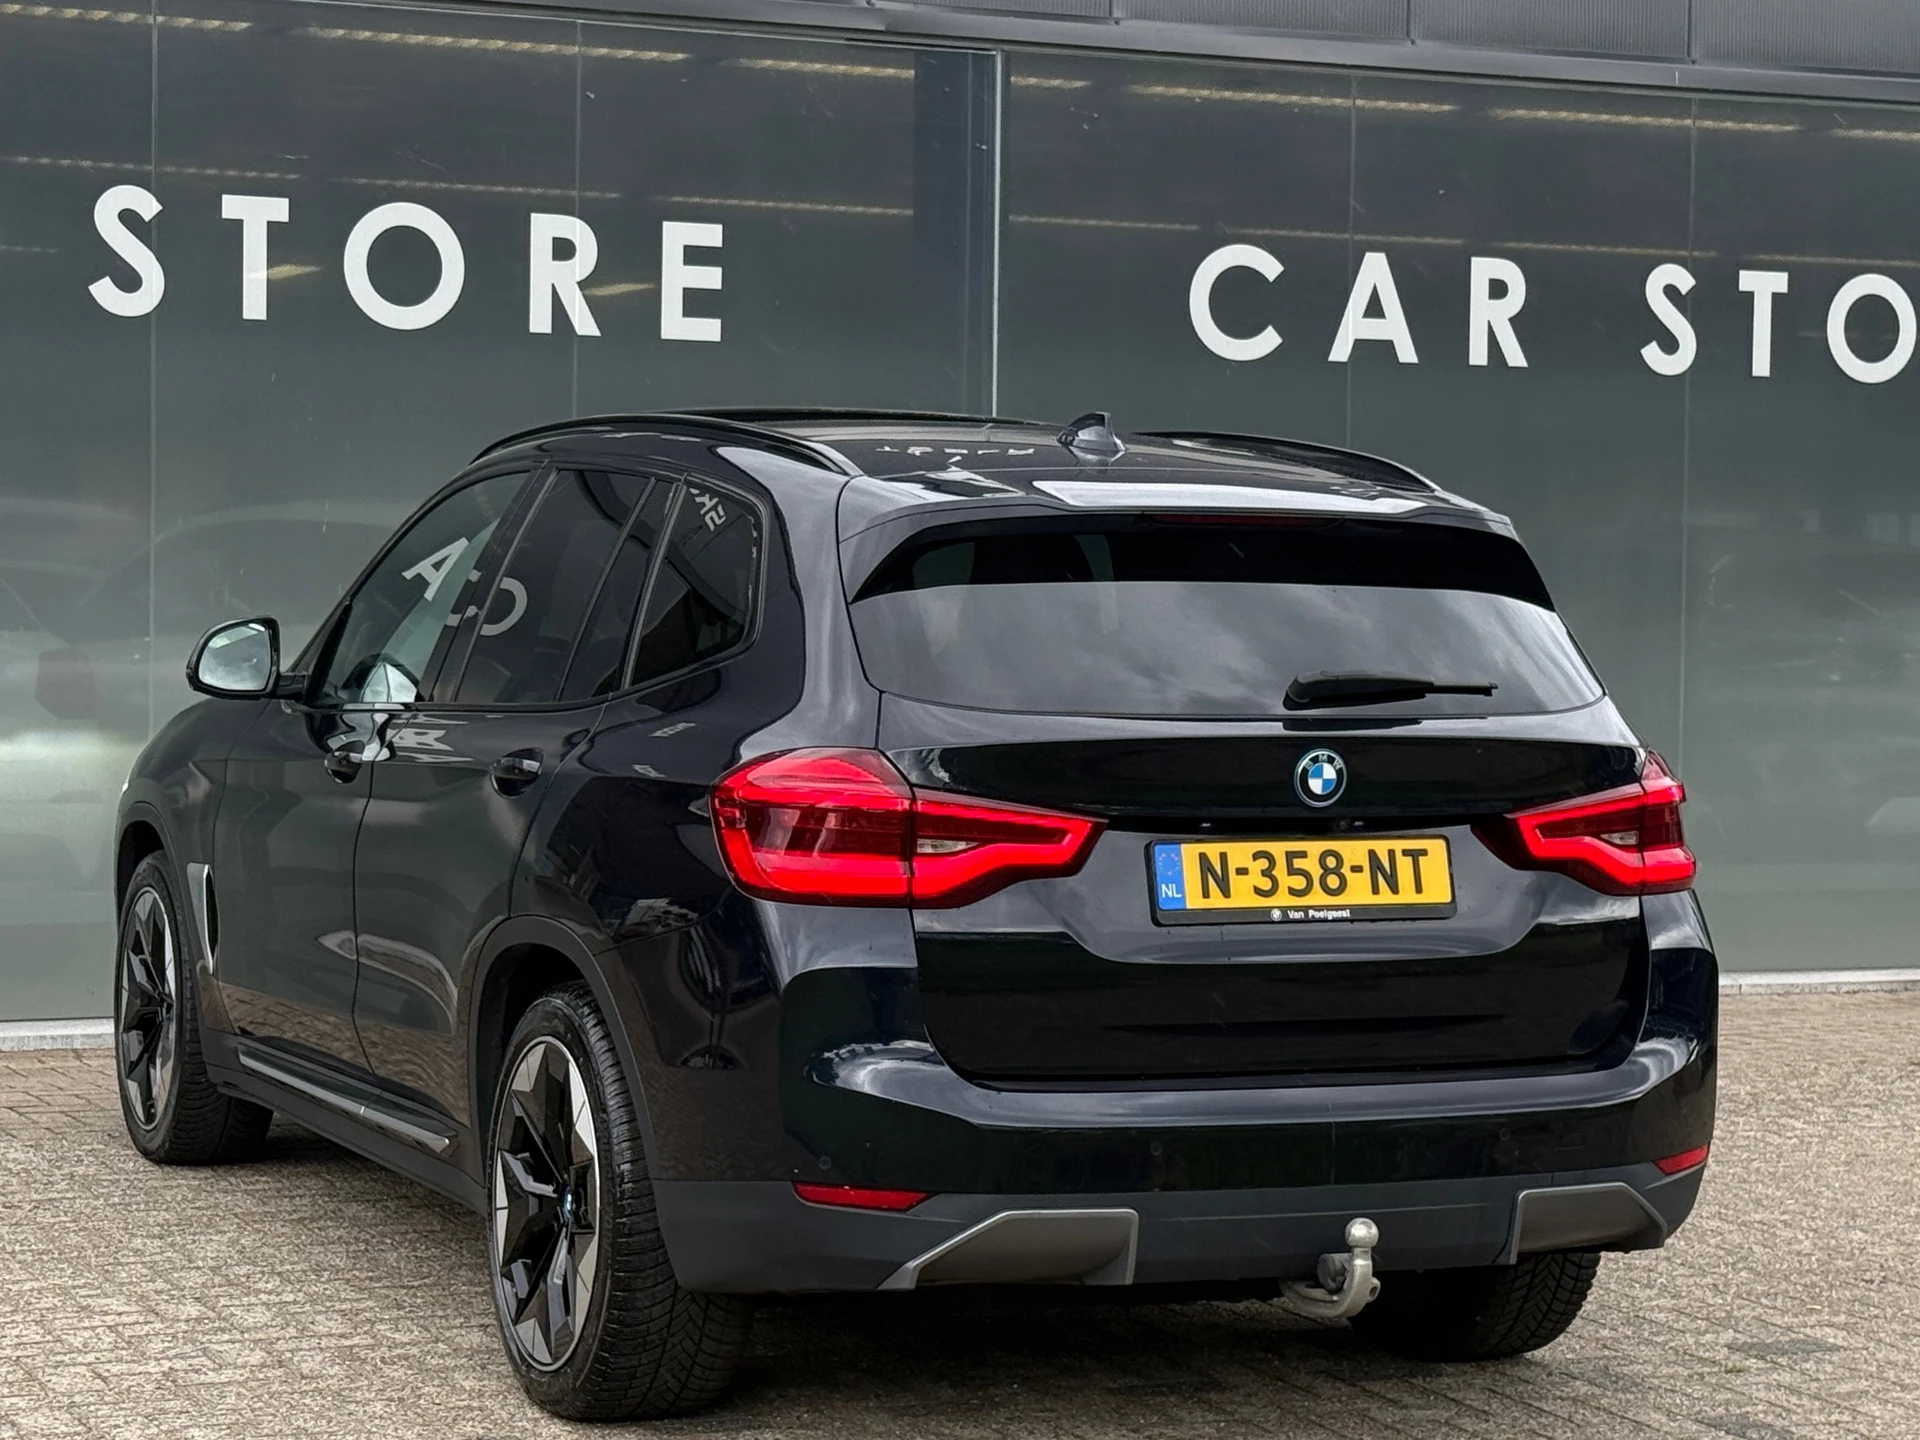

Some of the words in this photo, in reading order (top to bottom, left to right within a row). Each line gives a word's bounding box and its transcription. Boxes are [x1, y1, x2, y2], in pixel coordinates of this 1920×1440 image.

[88, 184, 724, 342] STORE
[1189, 244, 1529, 368] CAR
[1640, 263, 1918, 384] STO
[1161, 883, 1182, 898] NL
[1198, 848, 1429, 899] N-358-NT
[1287, 909, 1305, 919] Van
